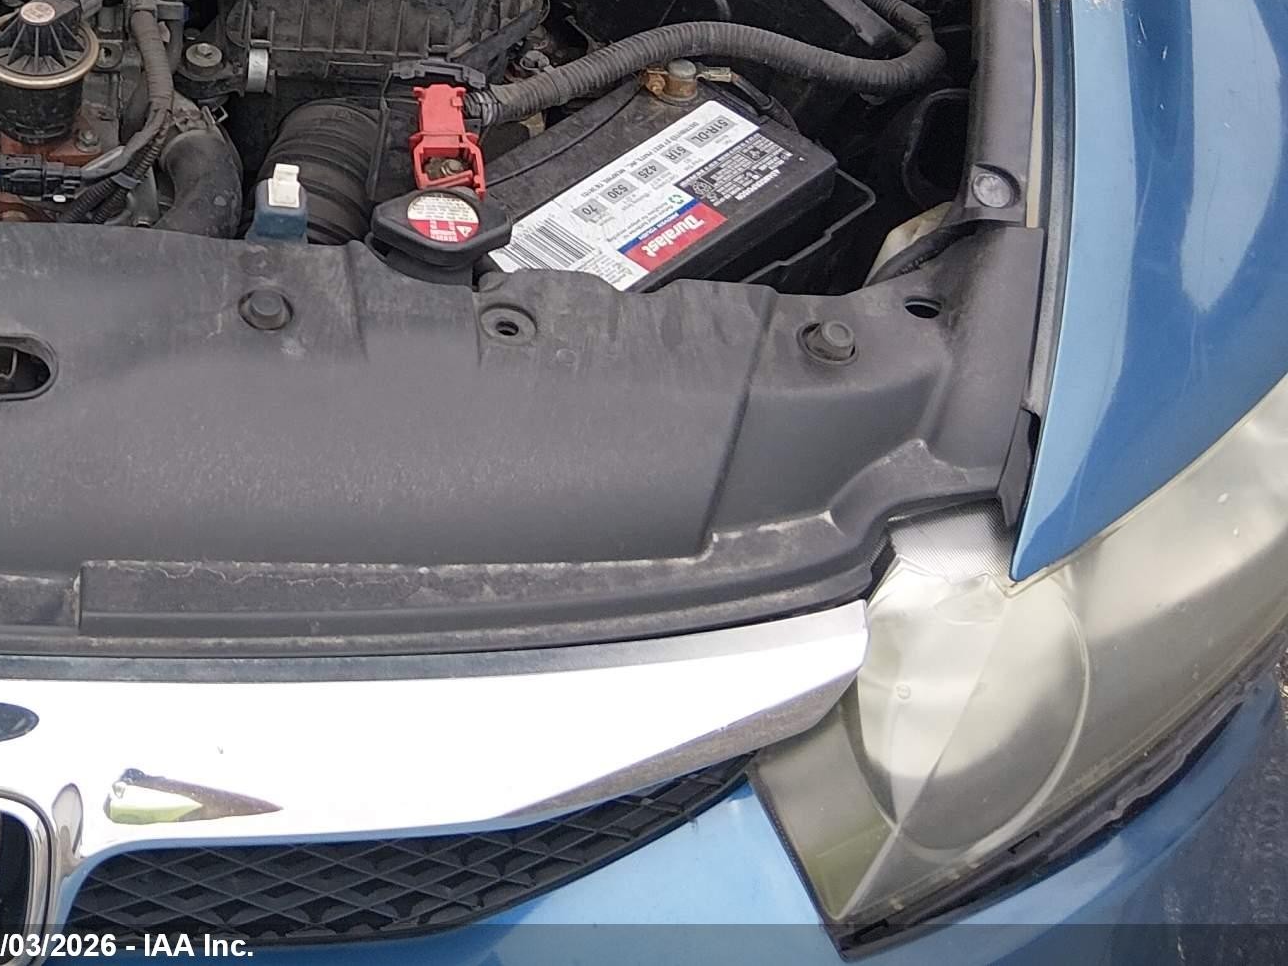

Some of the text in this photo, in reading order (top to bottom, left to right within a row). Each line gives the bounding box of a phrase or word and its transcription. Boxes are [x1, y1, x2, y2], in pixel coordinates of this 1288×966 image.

[666, 145, 687, 161] 51R
[637, 163, 658, 179] 425
[607, 183, 628, 199] 530
[582, 204, 598, 216] 70
[641, 214, 705, 258] Duralast
